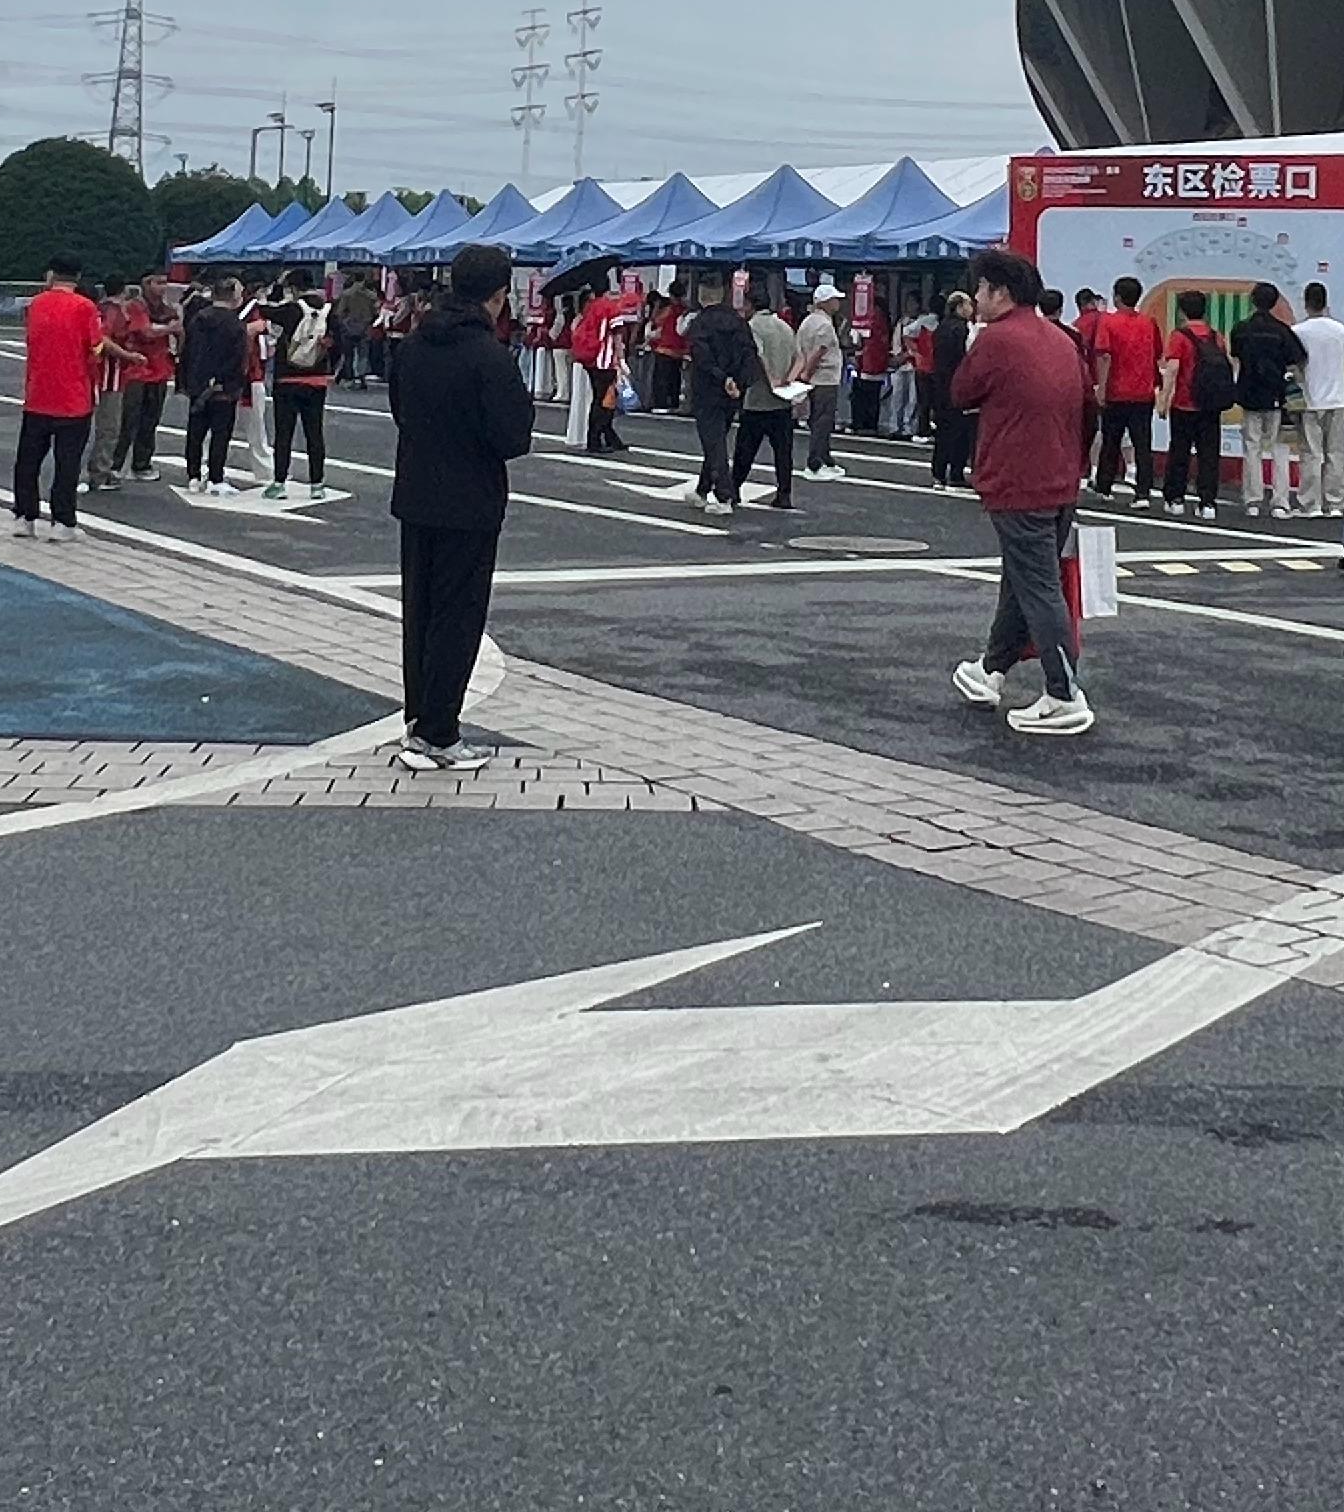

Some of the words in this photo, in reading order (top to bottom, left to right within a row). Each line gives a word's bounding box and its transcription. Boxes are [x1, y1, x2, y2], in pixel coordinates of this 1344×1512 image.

[1143, 162, 1317, 198] 东区检票口
